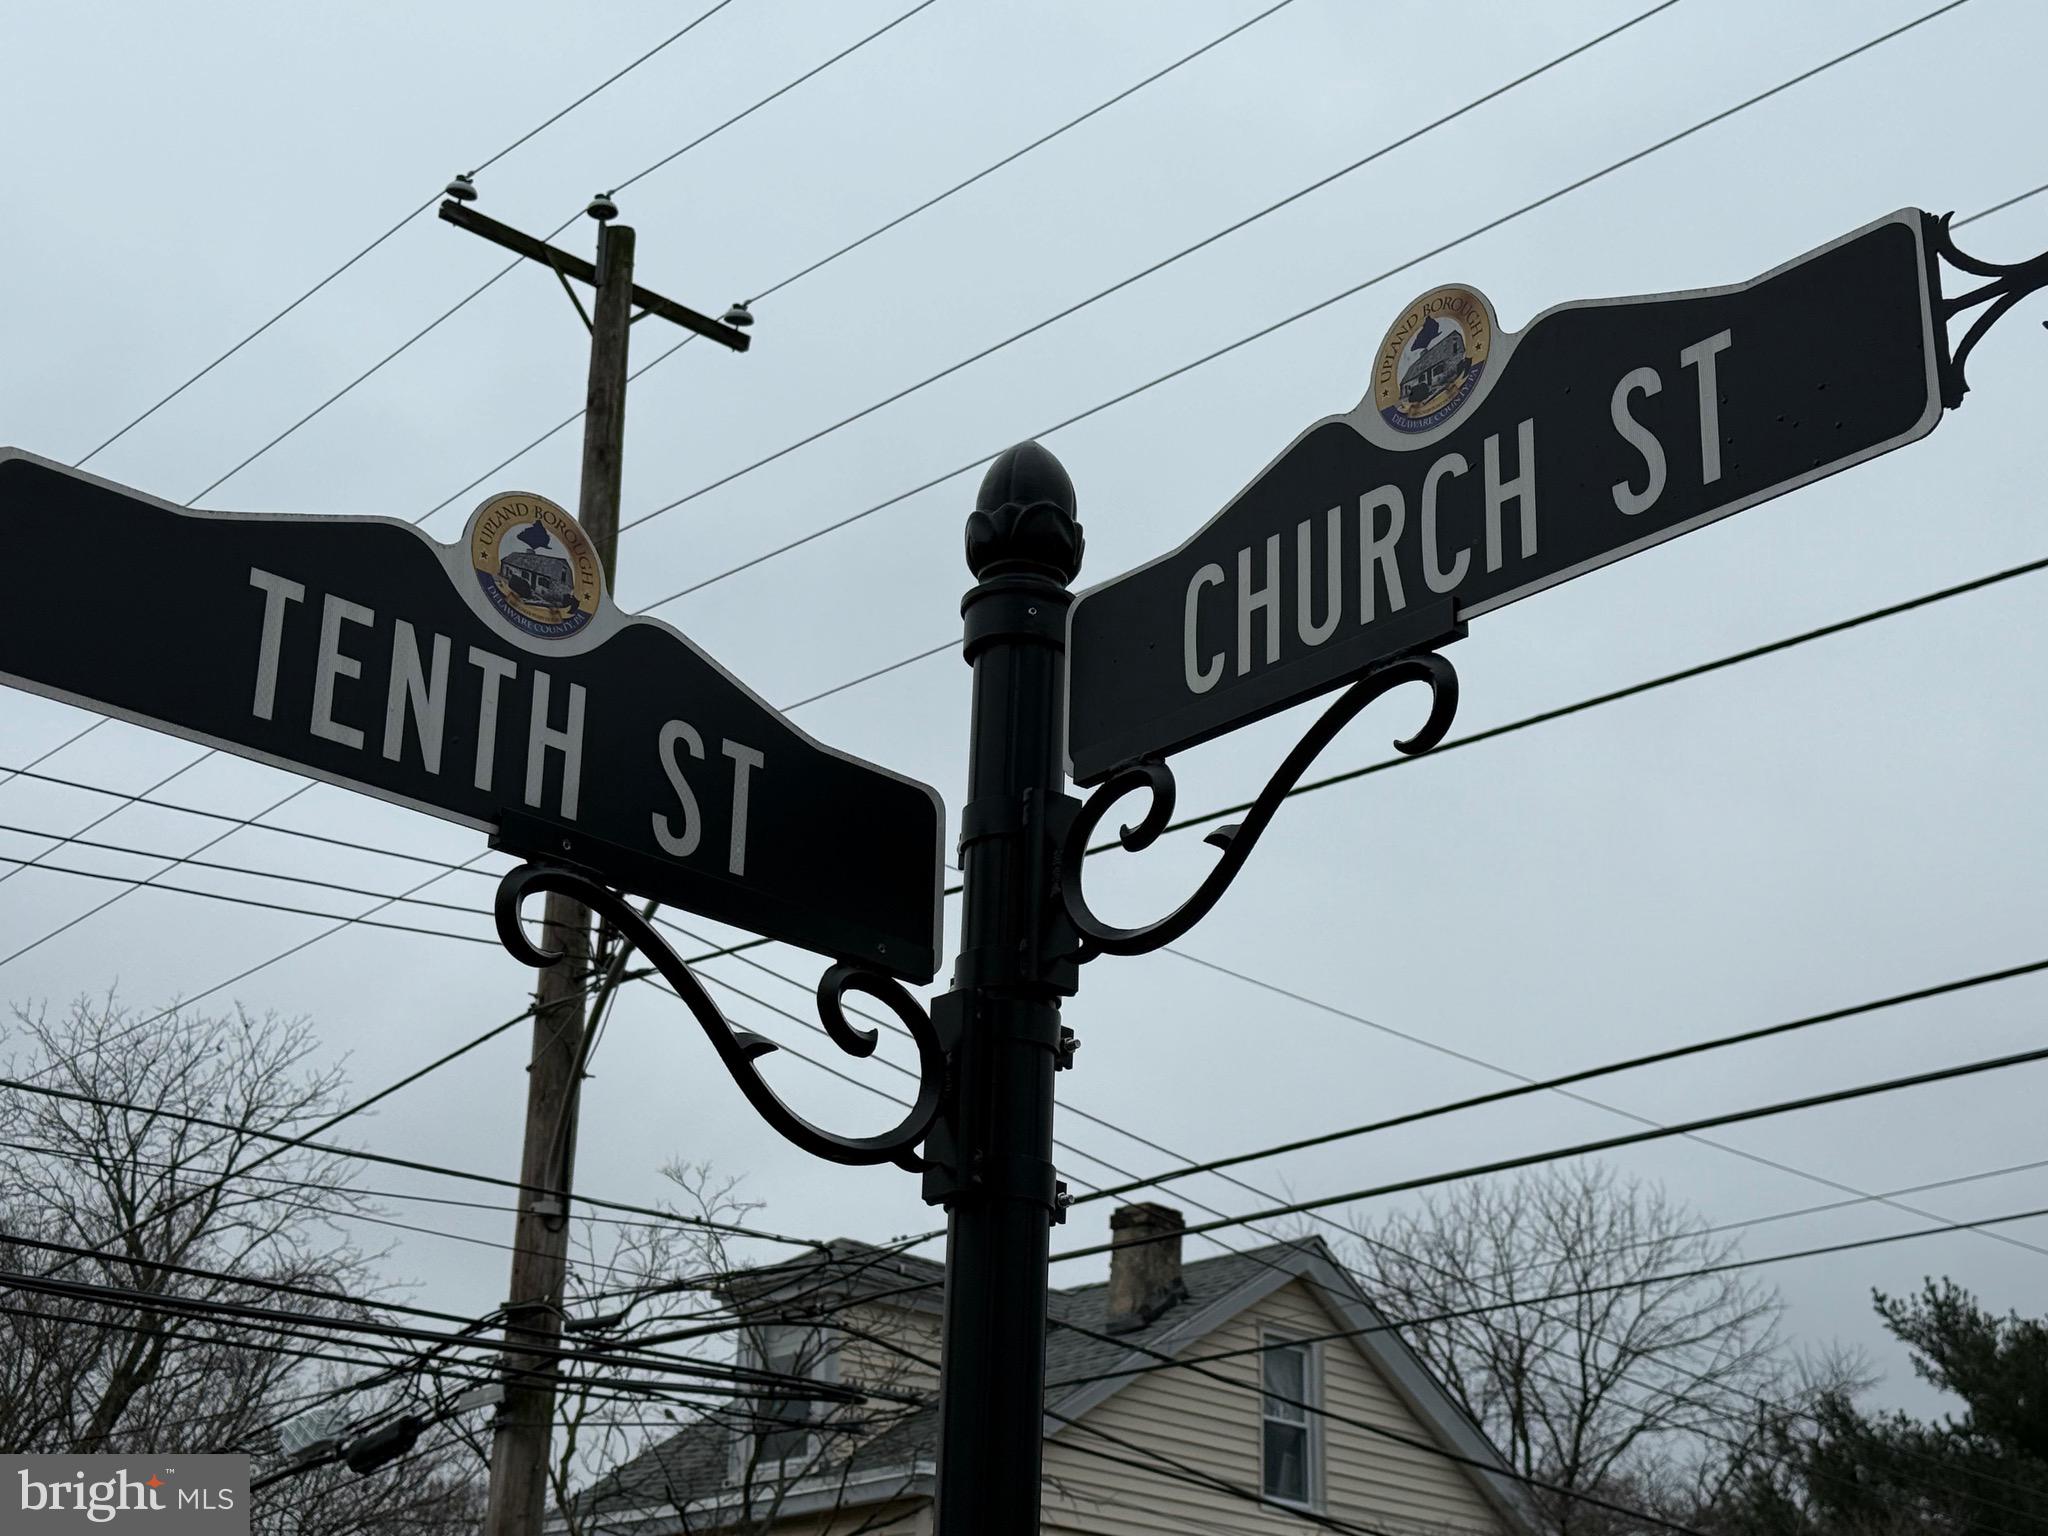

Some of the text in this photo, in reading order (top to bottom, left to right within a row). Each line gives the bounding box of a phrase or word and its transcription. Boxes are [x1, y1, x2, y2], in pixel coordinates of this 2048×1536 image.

[1380, 296, 1483, 384] UPLAND BOROUGH
[1391, 413, 1433, 429] DELAWARE
[479, 502, 593, 586] UPLAND BOROUGH
[1184, 328, 1732, 694] CHURCH ST
[487, 585, 533, 629] DELAWARE
[249, 567, 765, 877] TENTH ST
